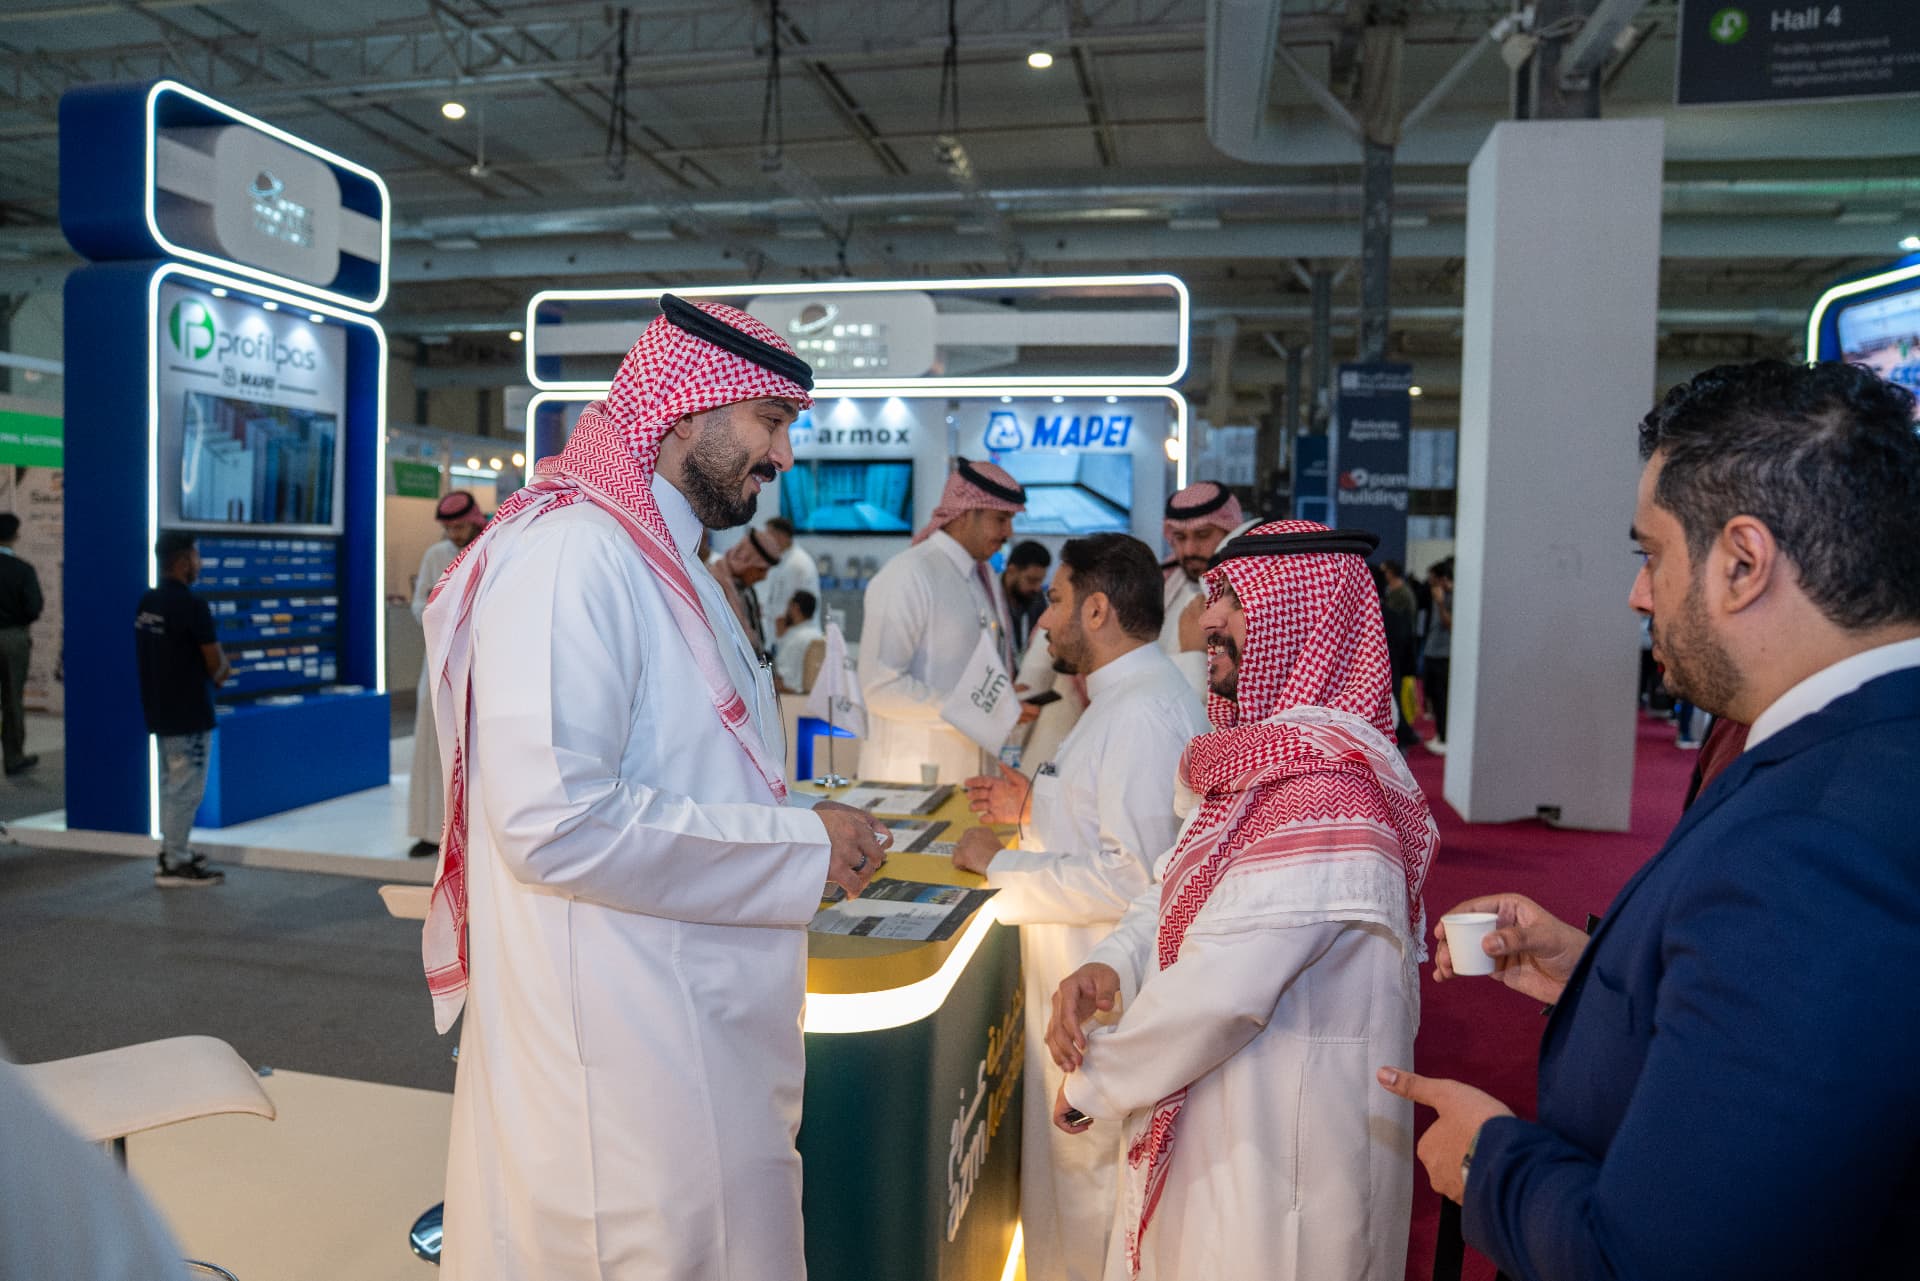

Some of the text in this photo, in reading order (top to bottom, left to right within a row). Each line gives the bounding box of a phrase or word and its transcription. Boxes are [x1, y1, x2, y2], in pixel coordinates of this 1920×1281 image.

[1770, 4, 1842, 32] Hall 4
[217, 331, 316, 373] profilpas
[1031, 416, 1132, 447] MAPEI
[1338, 490, 1407, 511] building
[982, 673, 1009, 714] azm
[947, 1119, 987, 1242] azm
